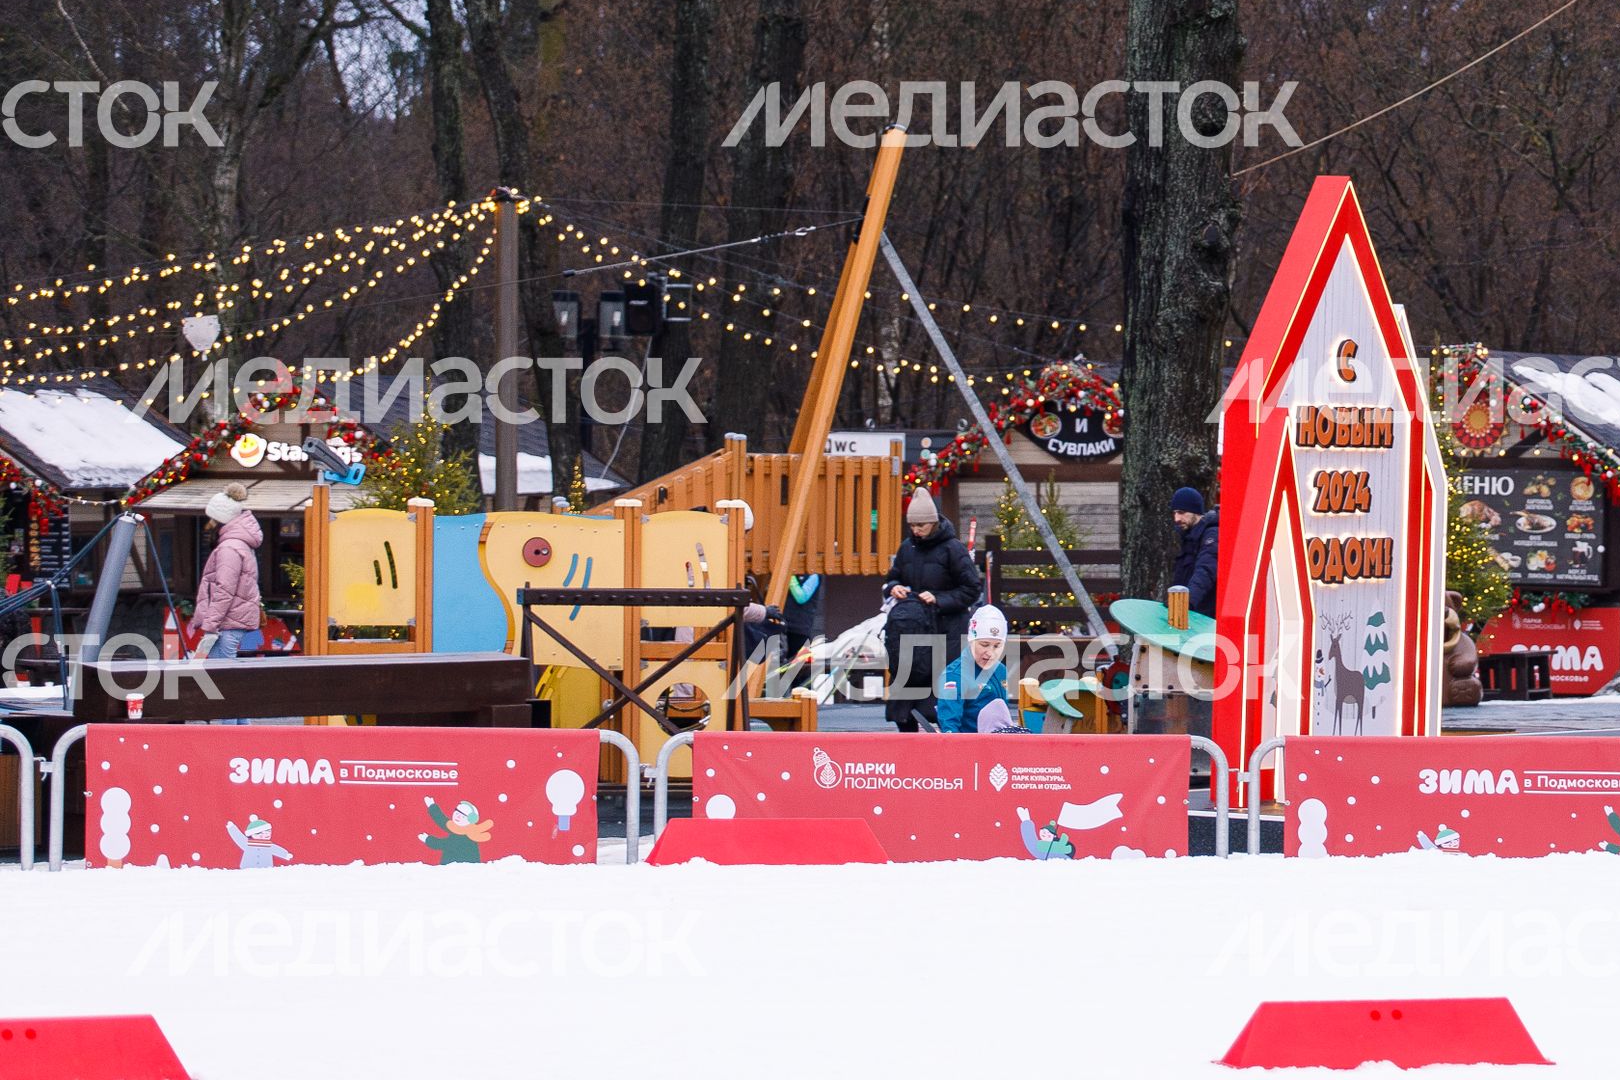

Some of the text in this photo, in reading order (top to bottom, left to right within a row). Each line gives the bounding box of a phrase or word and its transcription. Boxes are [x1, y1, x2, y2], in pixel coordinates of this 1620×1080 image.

[1337, 339, 1358, 382] С
[1075, 418, 1088, 433] И
[1296, 406, 1394, 448] НОВЫМ
[835, 440, 857, 453] WC
[1048, 438, 1116, 456] СУВЛАКИ
[1313, 471, 1372, 513] 2024
[1306, 537, 1393, 584] ОДОМ!
[1511, 644, 1604, 671] МА
[229, 757, 459, 784] ЗИМА в Подмосковье
[845, 762, 896, 775] ПАРКИ
[1011, 766, 1063, 774] ОДИНЦОВСКИЙ
[844, 777, 963, 790] ПОДМОСКОВЬЯ
[1418, 769, 1520, 794] ЗИМА
[1524, 779, 1532, 788] в
